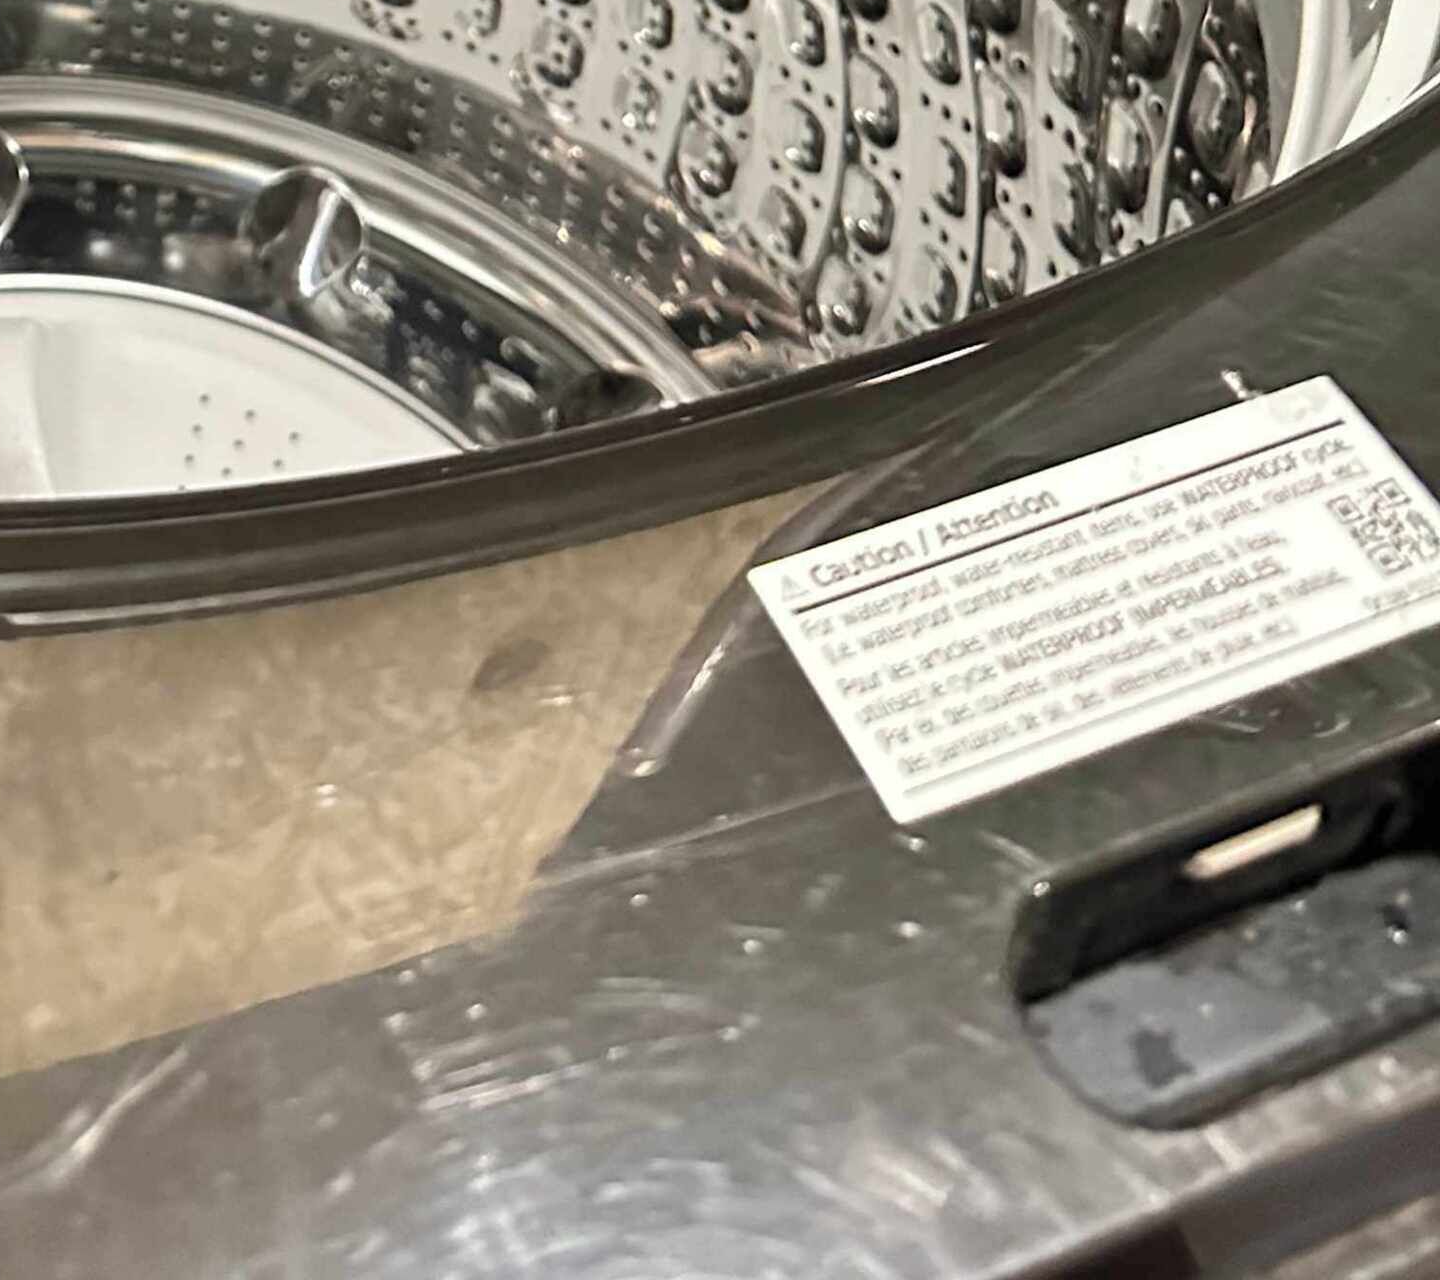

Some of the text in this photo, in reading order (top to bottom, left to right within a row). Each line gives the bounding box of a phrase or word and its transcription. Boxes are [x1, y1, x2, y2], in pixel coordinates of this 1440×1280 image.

[1180, 451, 1298, 506] WATERPROOF
[810, 539, 916, 587] Caution
[935, 490, 1060, 546] Attention
